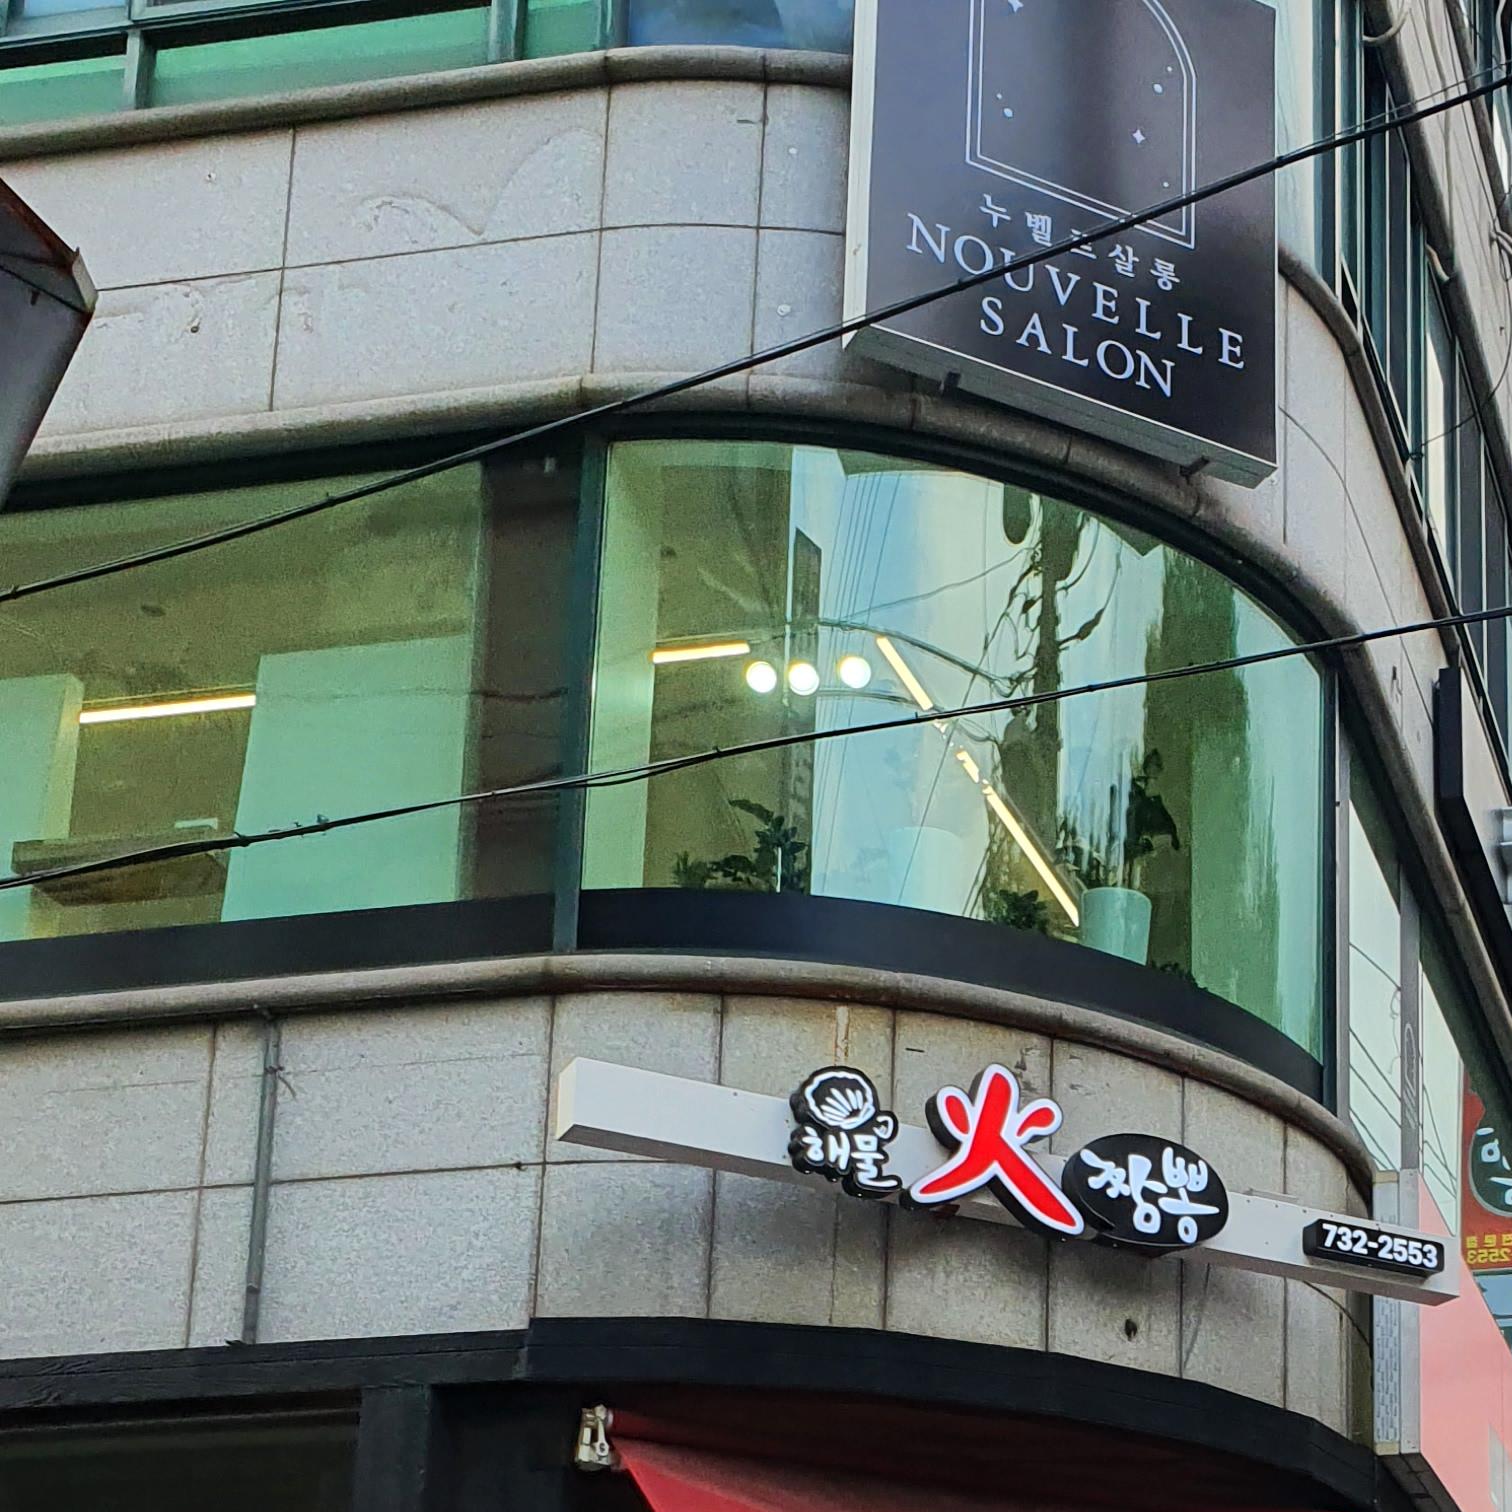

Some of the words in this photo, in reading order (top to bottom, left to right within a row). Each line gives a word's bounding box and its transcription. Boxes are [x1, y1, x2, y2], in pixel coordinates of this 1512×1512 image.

[906, 212, 1245, 370] NOUVELLE
[980, 296, 1175, 397] SALON
[801, 1129, 899, 1191] 해물
[910, 1063, 1085, 1236] 火
[1320, 1222, 1439, 1269] 732-2553
